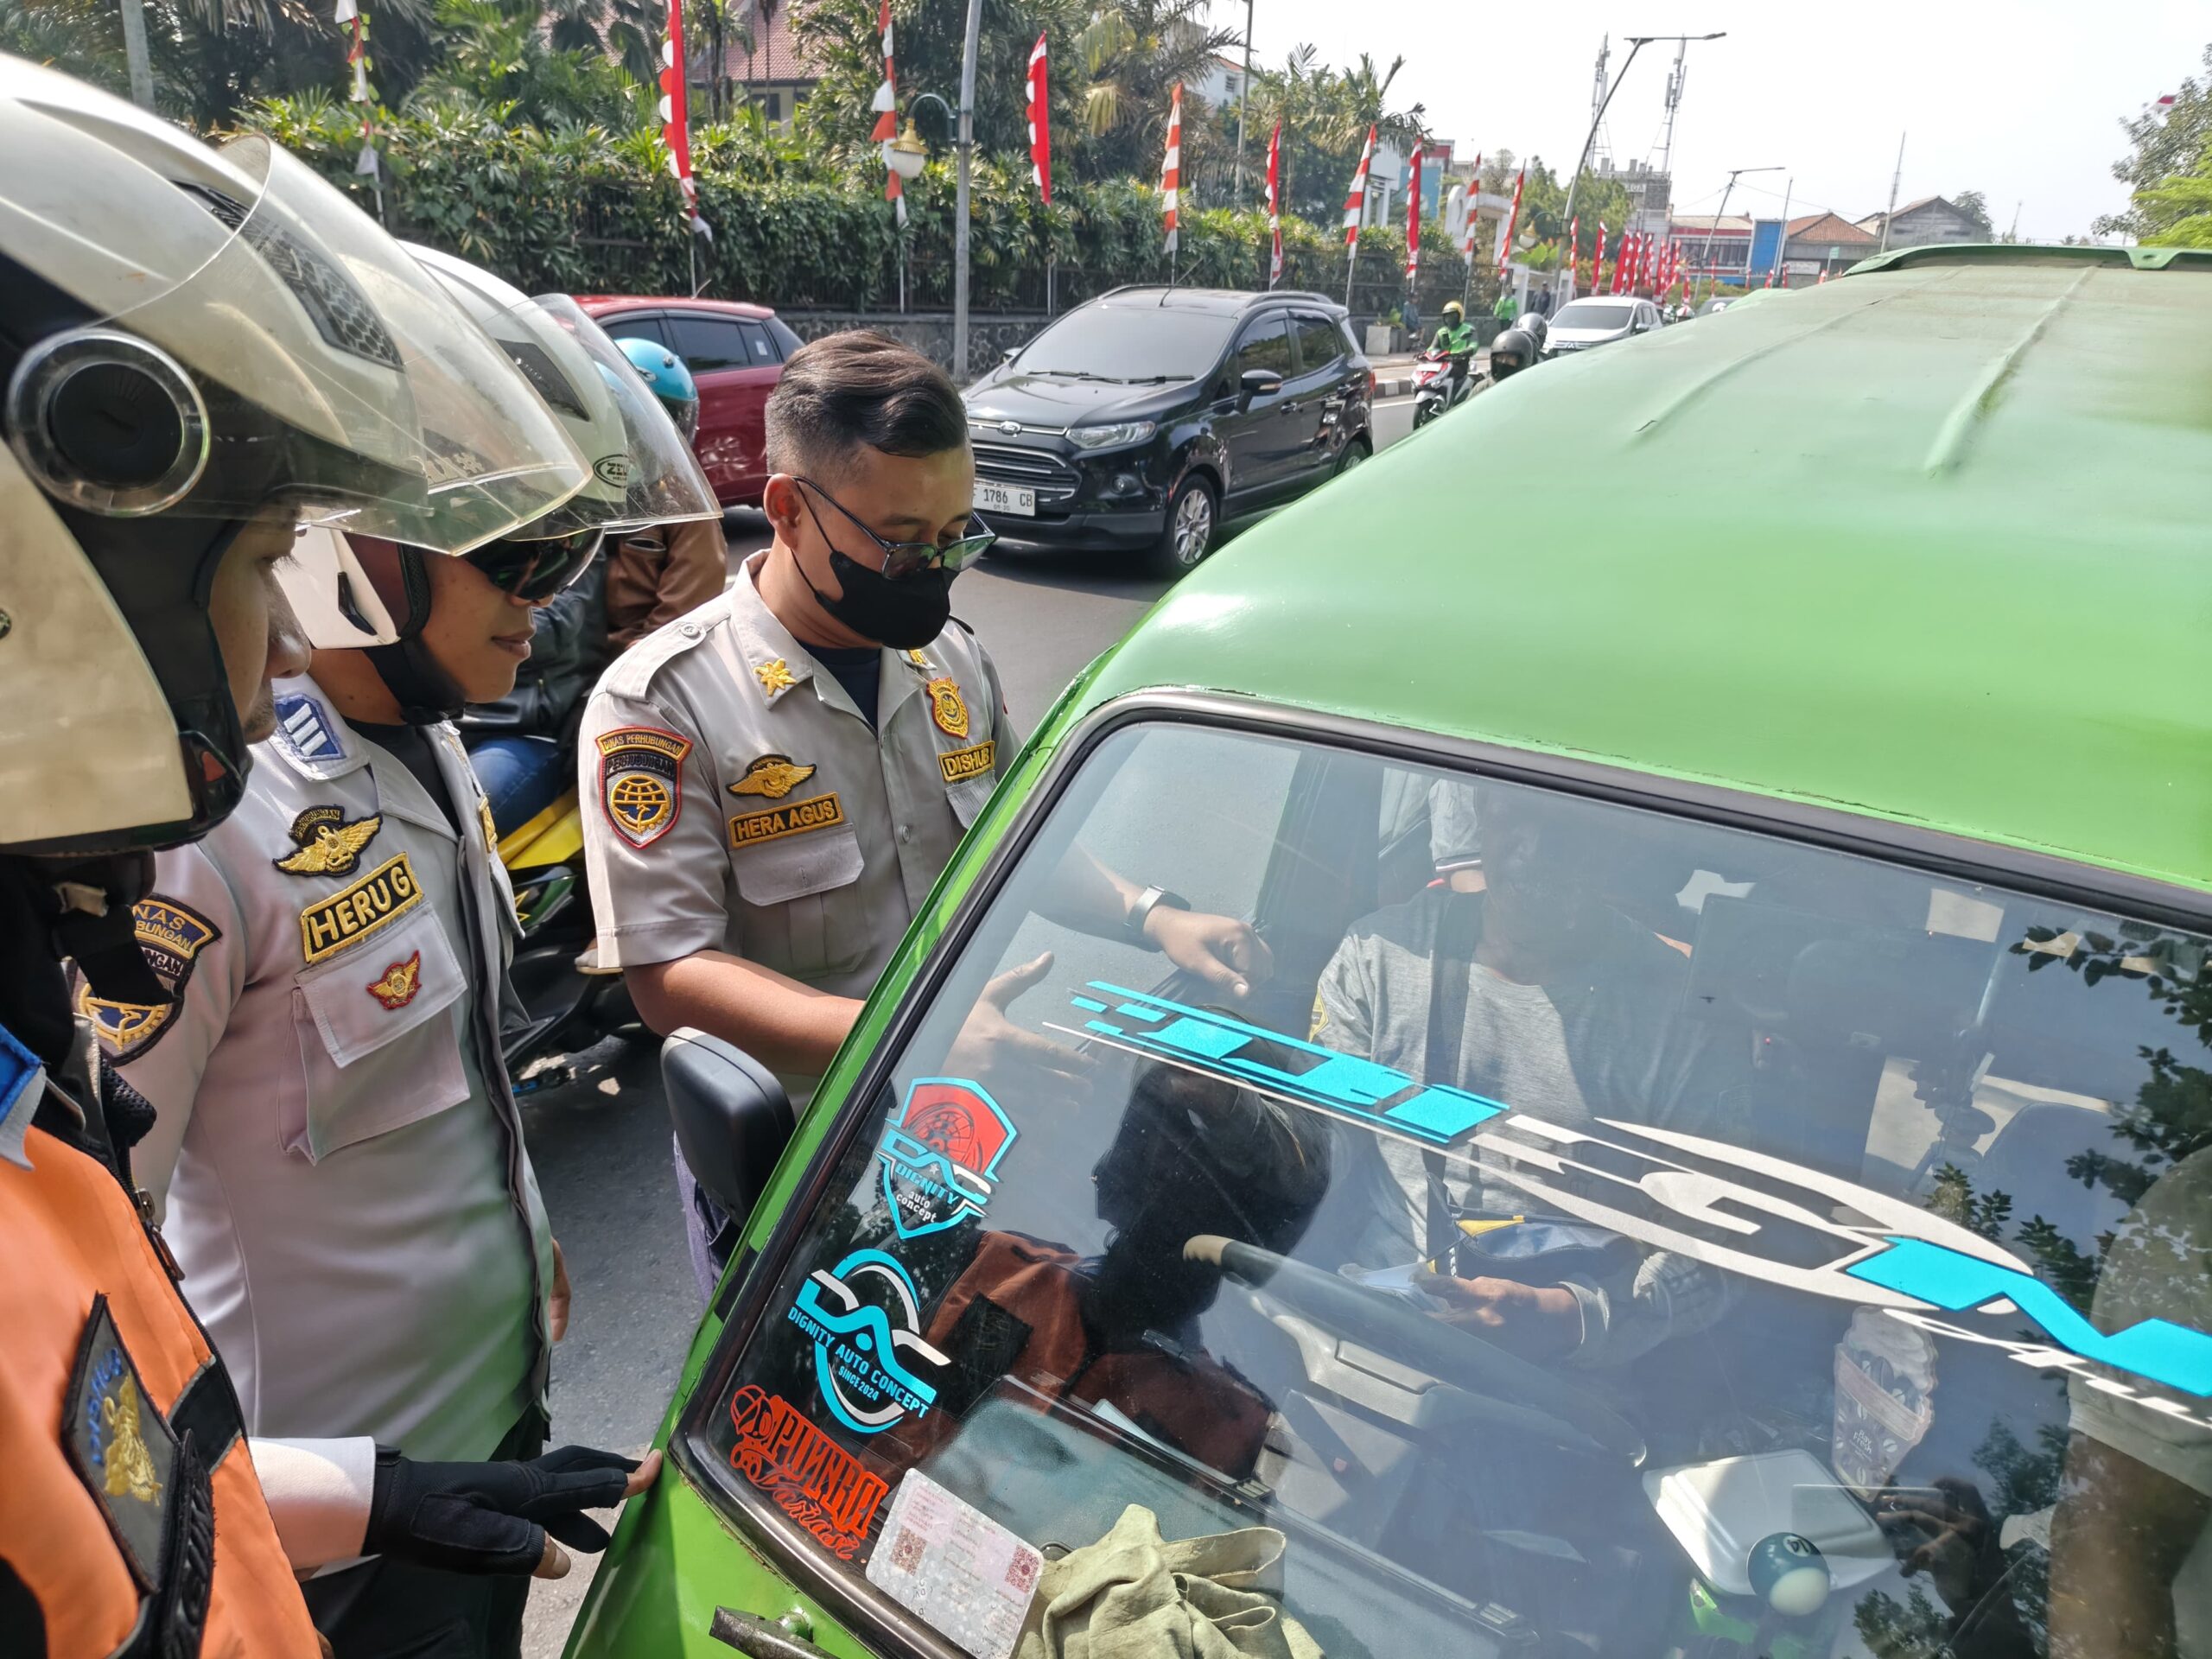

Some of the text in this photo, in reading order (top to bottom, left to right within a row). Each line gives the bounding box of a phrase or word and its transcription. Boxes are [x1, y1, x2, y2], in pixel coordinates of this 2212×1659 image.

[983, 488, 1008, 504] 1786
[1020, 493, 1033, 507] CB
[603, 733, 683, 754] DINAS PERHUBUNGAN
[944, 747, 990, 776] DISHUB
[736, 800, 836, 841] HERA AGUS
[132, 905, 187, 931] NAS
[310, 866, 411, 949] HERU G
[136, 919, 192, 951] BUNGAN
[894, 1163, 958, 1205] DIGNITY
[896, 1193, 937, 1224] concept
[908, 1191, 931, 1209] auto
[787, 1306, 929, 1419] DIGNITY AUTO CONCEPT
[838, 1365, 880, 1402] SINCE 2024
